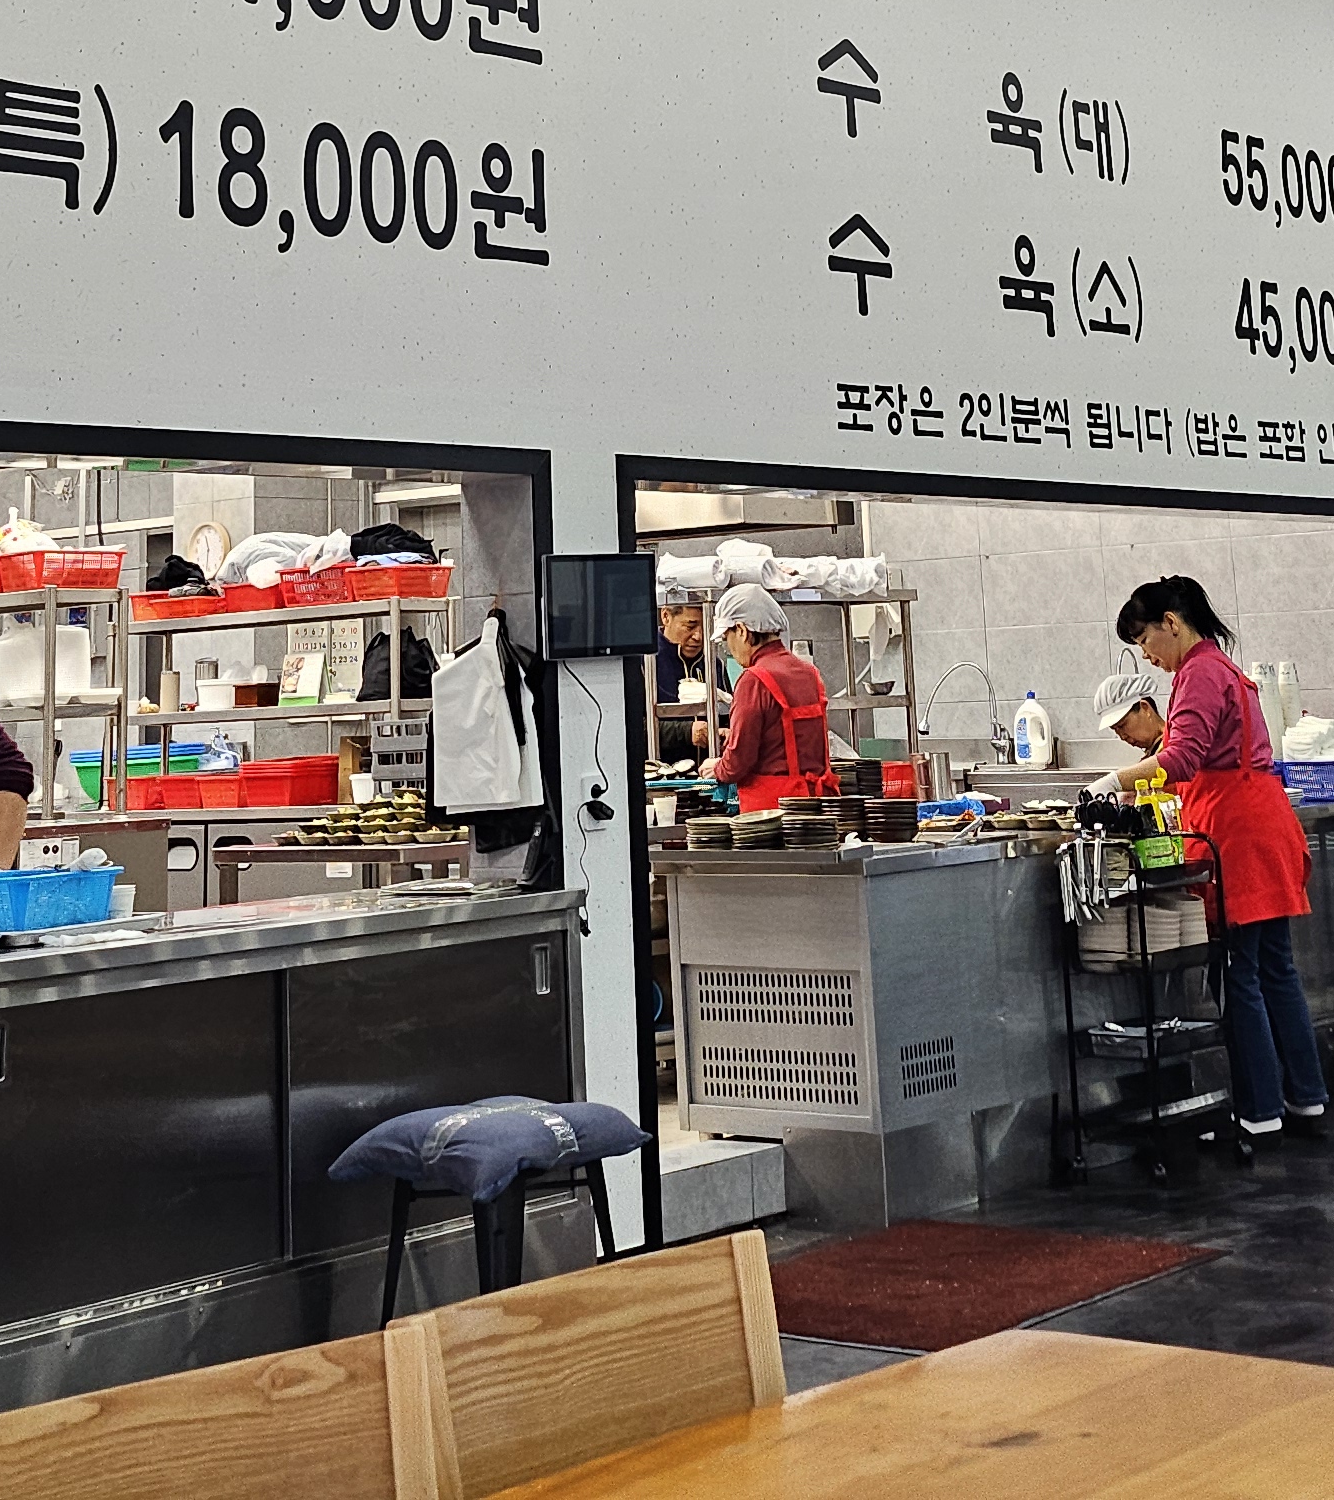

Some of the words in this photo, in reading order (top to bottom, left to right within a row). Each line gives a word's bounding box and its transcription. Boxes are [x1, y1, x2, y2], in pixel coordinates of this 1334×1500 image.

[157, 99, 550, 267] 18,000원
[836, 381, 945, 439] 포장은
[958, 391, 1073, 450] 2인분씩
[1086, 402, 1173, 456] 됩니다
[1184, 407, 1248, 460] (밥은
[1257, 419, 1307, 464] 포함
